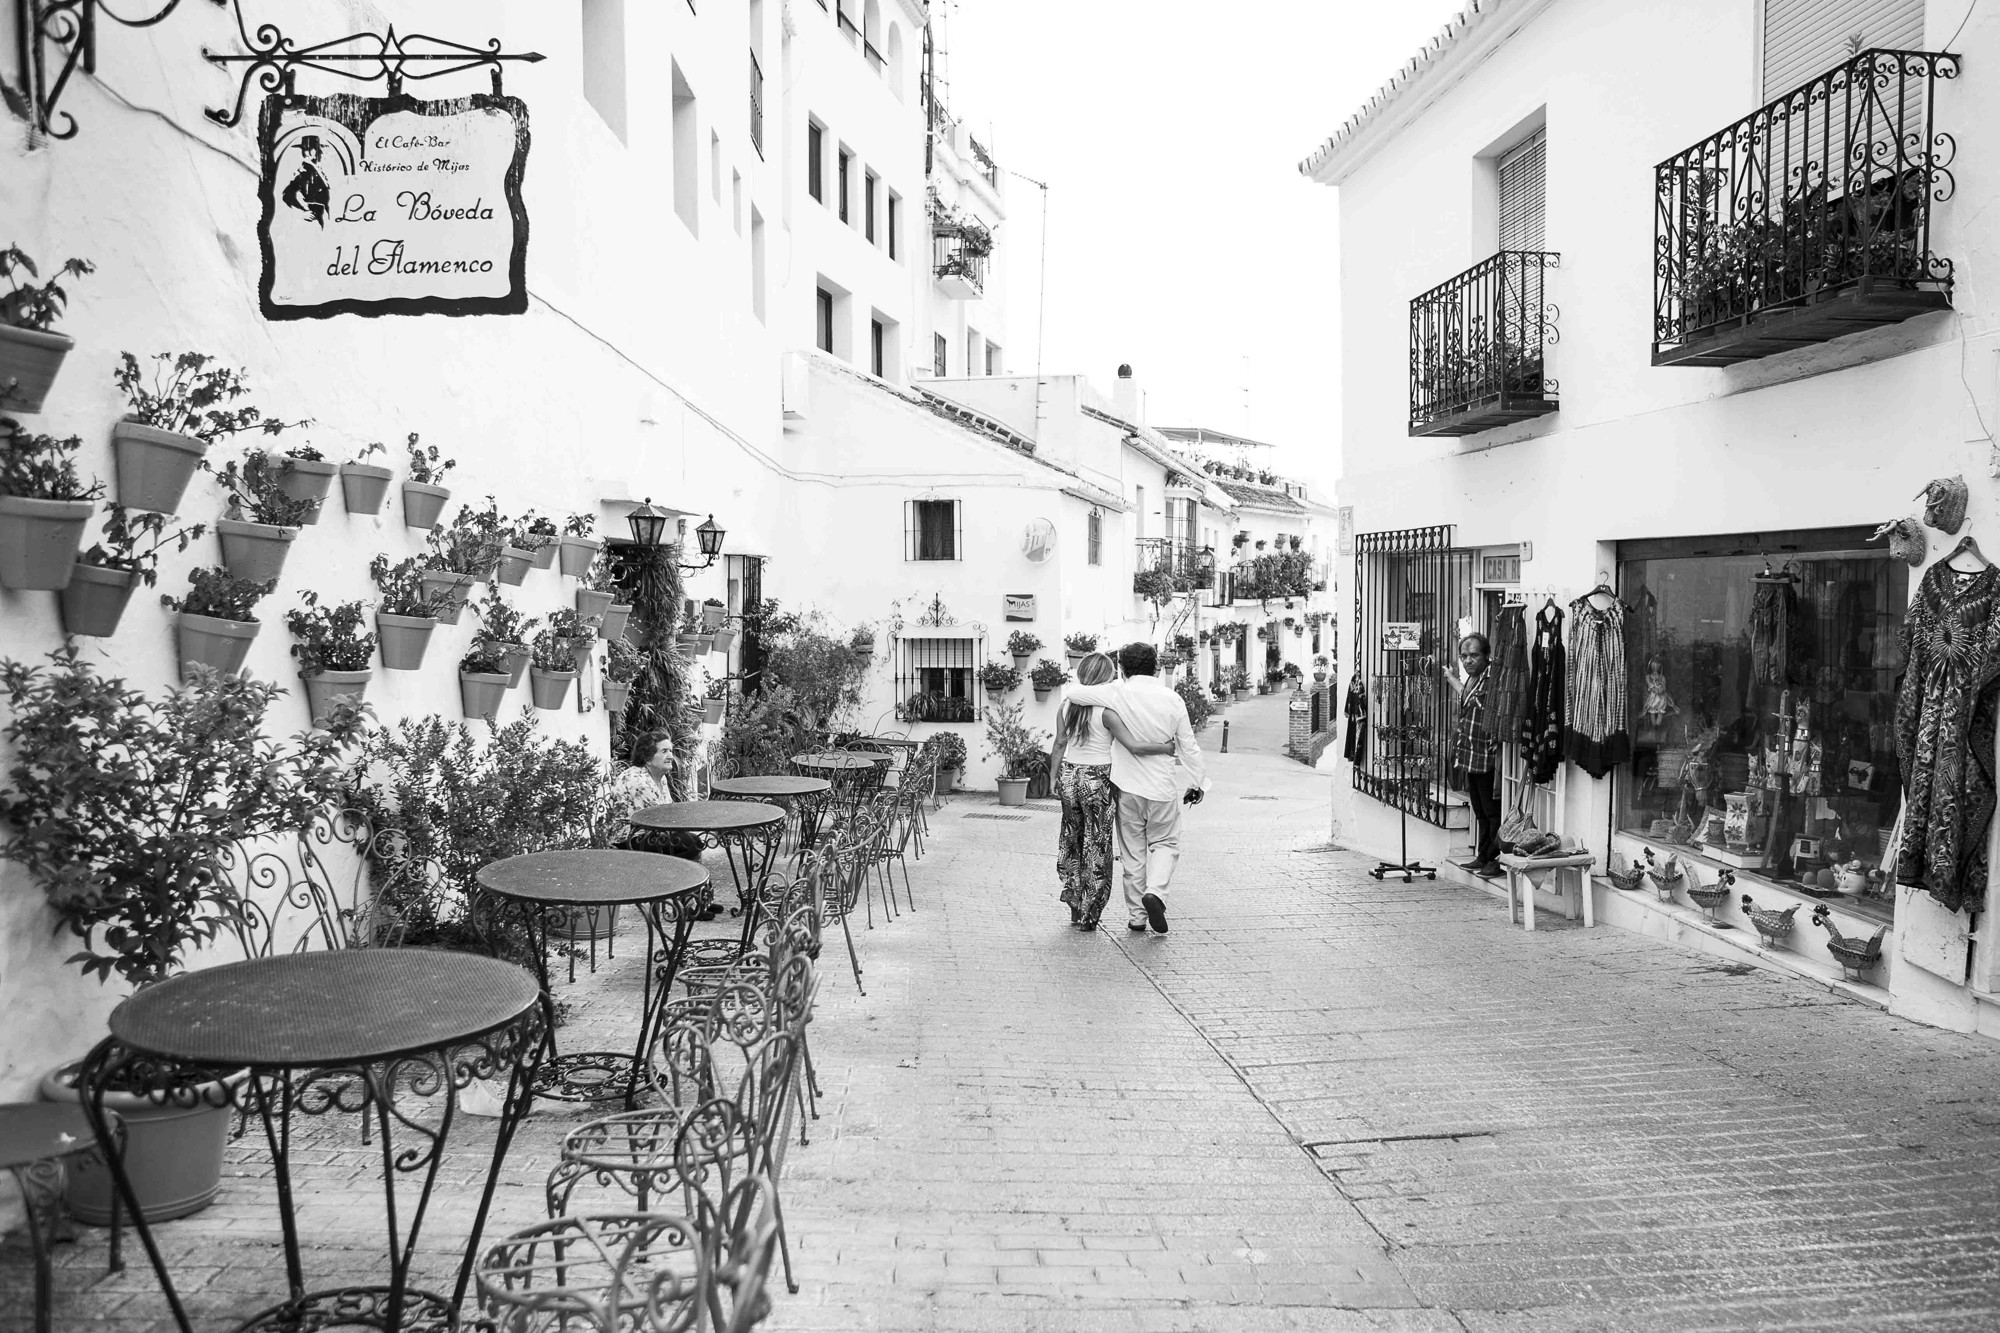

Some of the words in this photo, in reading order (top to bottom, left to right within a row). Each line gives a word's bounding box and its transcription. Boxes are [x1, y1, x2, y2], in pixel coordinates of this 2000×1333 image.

[375, 136, 389, 149] El
[359, 160, 412, 172] Histórico
[417, 161, 429, 171] de
[433, 158, 470, 175] Mijas
[335, 194, 377, 223] La
[396, 191, 494, 221] Bóveda
[327, 245, 360, 276] del
[367, 239, 494, 275] Flamenco
[1487, 559, 1507, 580] CASA
[1006, 598, 1030, 609] MIJAS
